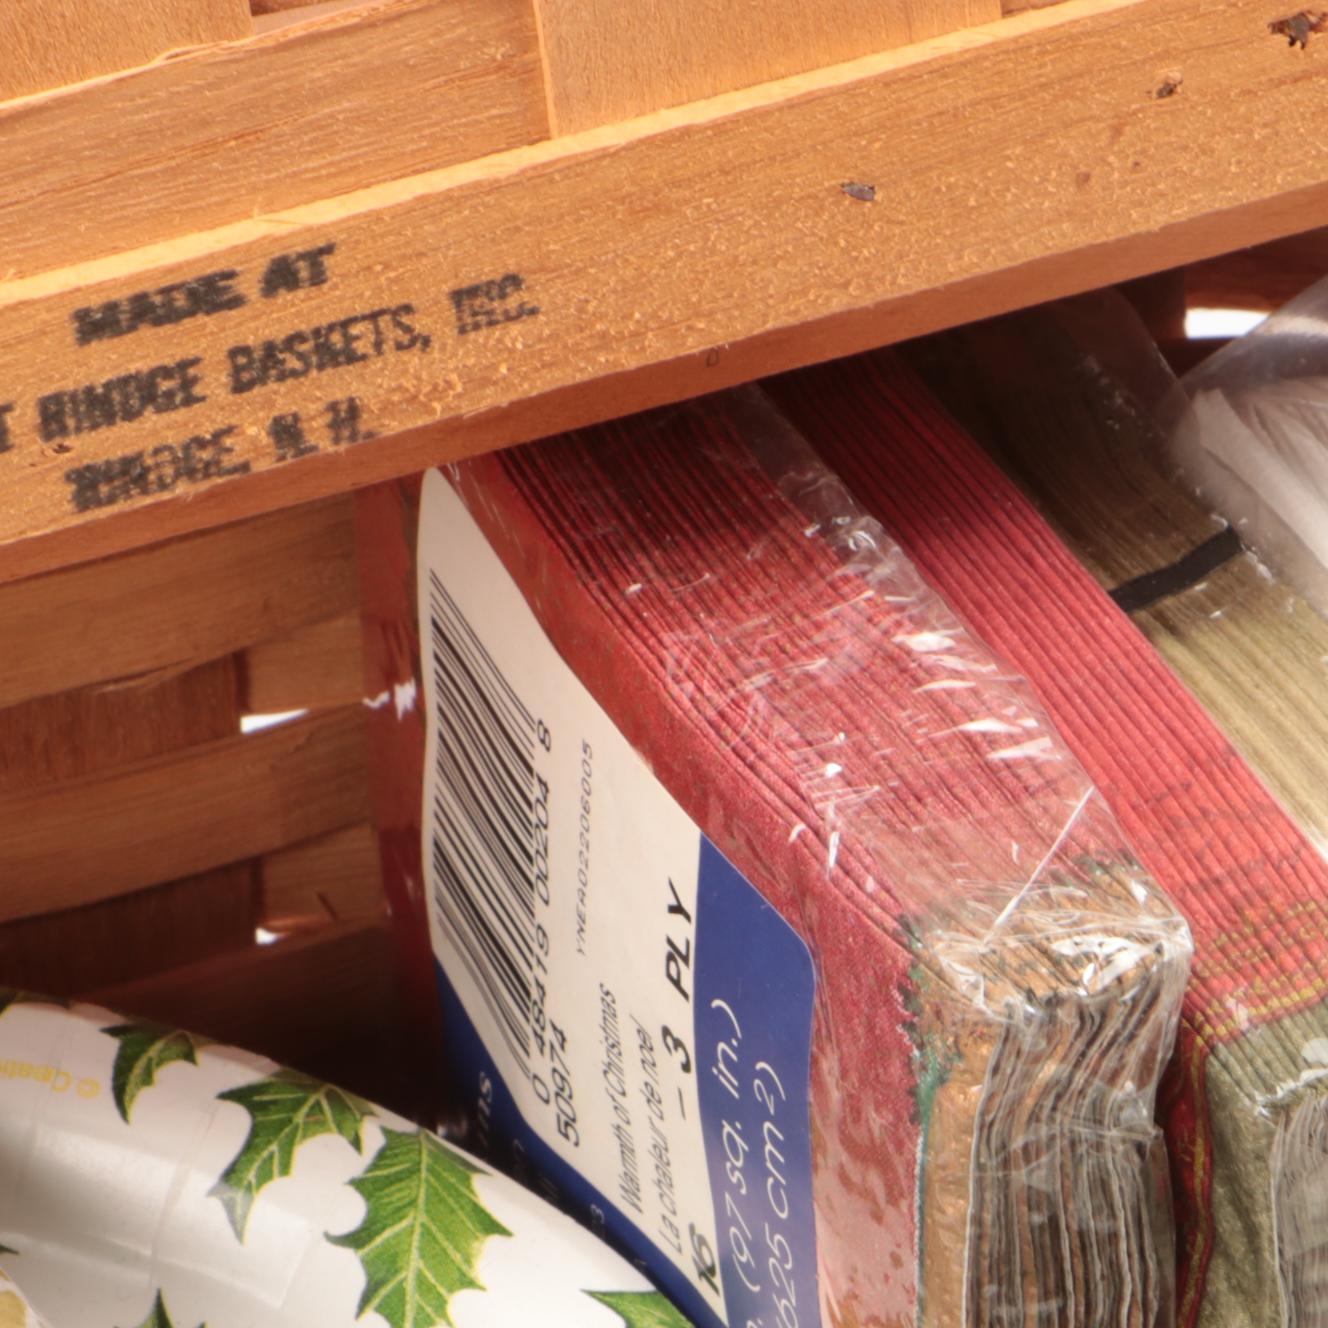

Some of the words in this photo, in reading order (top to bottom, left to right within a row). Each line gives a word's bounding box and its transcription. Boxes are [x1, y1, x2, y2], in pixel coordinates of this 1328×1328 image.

[70, 269, 247, 346] MADE
[259, 242, 337, 298] AT
[226, 304, 432, 394] BASKETS,
[537, 718, 552, 753] 8
[534, 771, 551, 907] 00204
[665, 877, 692, 1004] PLY
[532, 923, 550, 1057] 48419
[549, 1018, 580, 1147] 50974
[599, 983, 627, 1099] Christmas
[661, 1025, 692, 1074] 3
[711, 999, 743, 1100] in.)
[532, 1072, 550, 1105] 0
[604, 1086, 631, 1127] of
[640, 1080, 665, 1121] de
[610, 1122, 644, 1215] Warmth
[647, 1115, 678, 1217] chaleur
[721, 1119, 749, 1195] sq.
[658, 1212, 682, 1256] La
[688, 1222, 722, 1298] 16
[725, 1191, 761, 1293] (97
